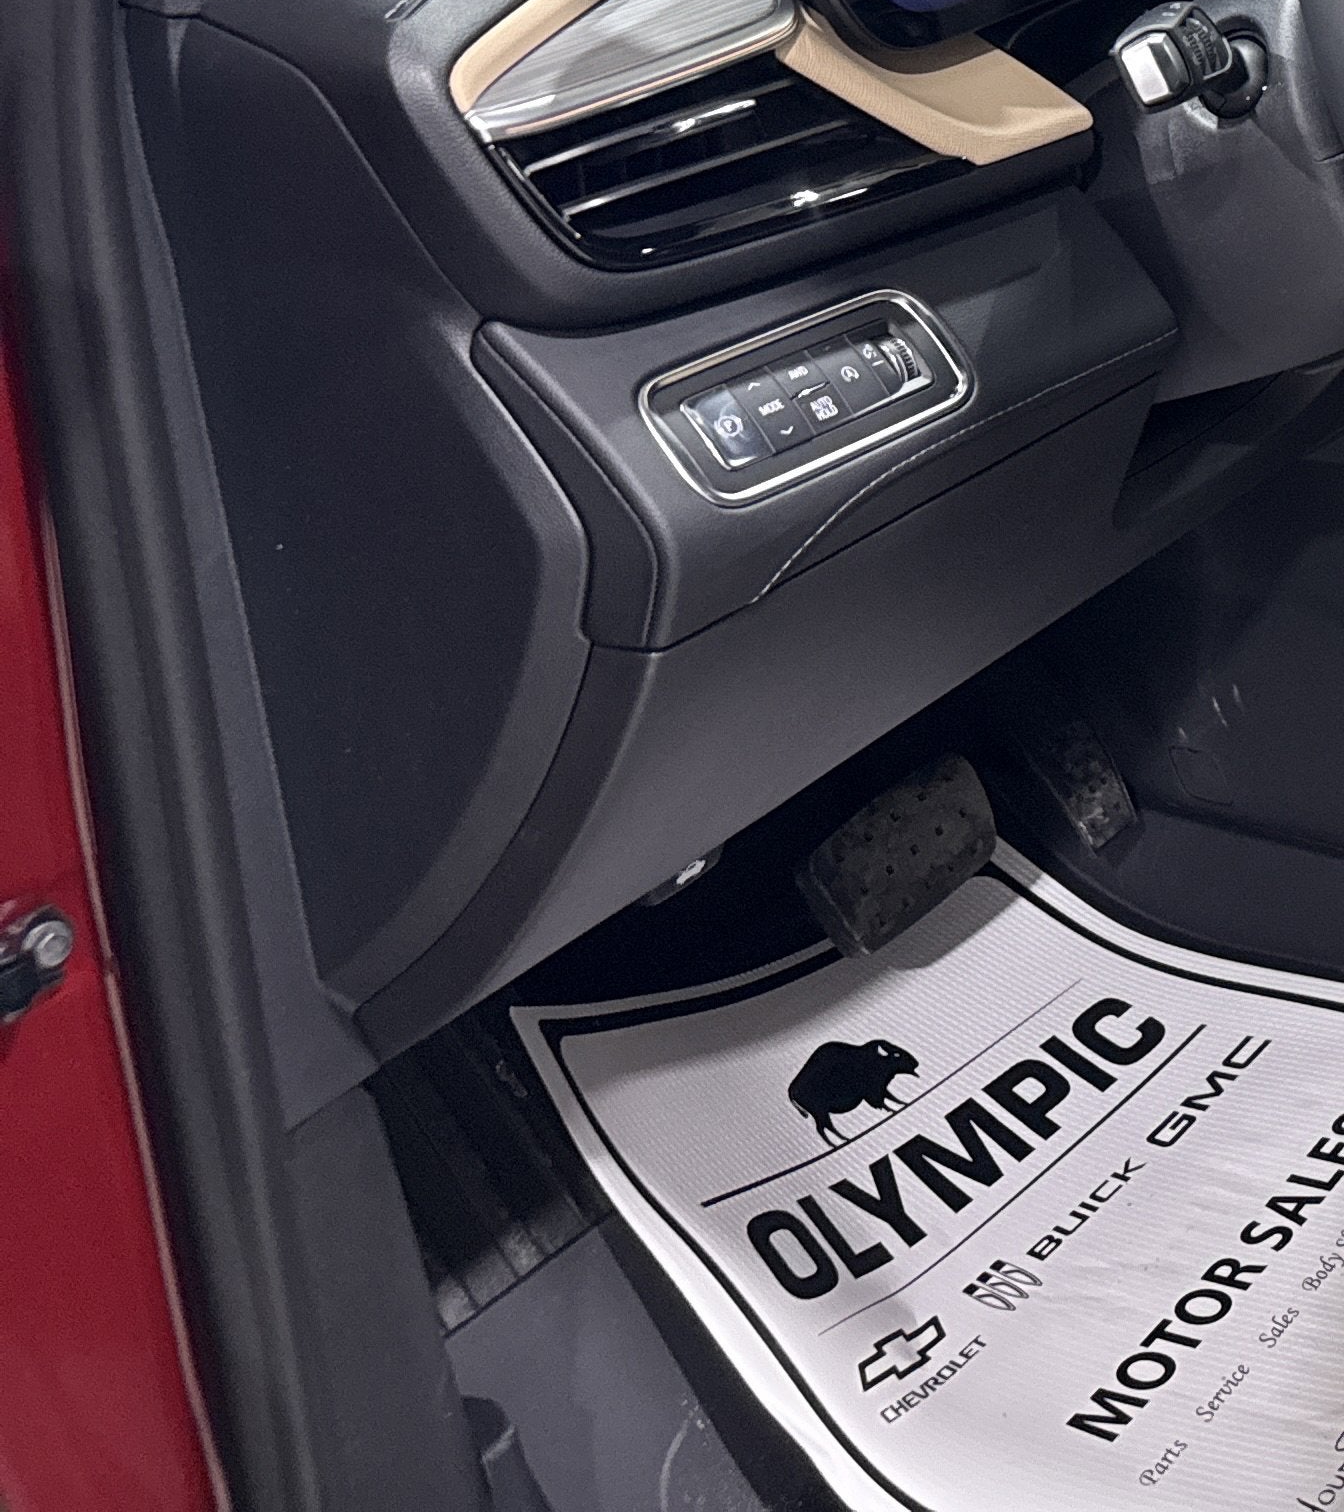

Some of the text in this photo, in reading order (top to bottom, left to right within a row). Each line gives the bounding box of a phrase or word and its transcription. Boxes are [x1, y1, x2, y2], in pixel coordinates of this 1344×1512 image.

[758, 399, 785, 416] MODE
[745, 996, 1167, 1301] OLYMPIC
[1025, 1035, 1273, 1262] BUICK GMC
[880, 1333, 987, 1424] CHEVROLET
[1065, 1257, 1268, 1444] MOTOR
[1138, 1437, 1189, 1488] Parts
[1195, 1362, 1251, 1423] Service
[1258, 1305, 1301, 1349] Sales
